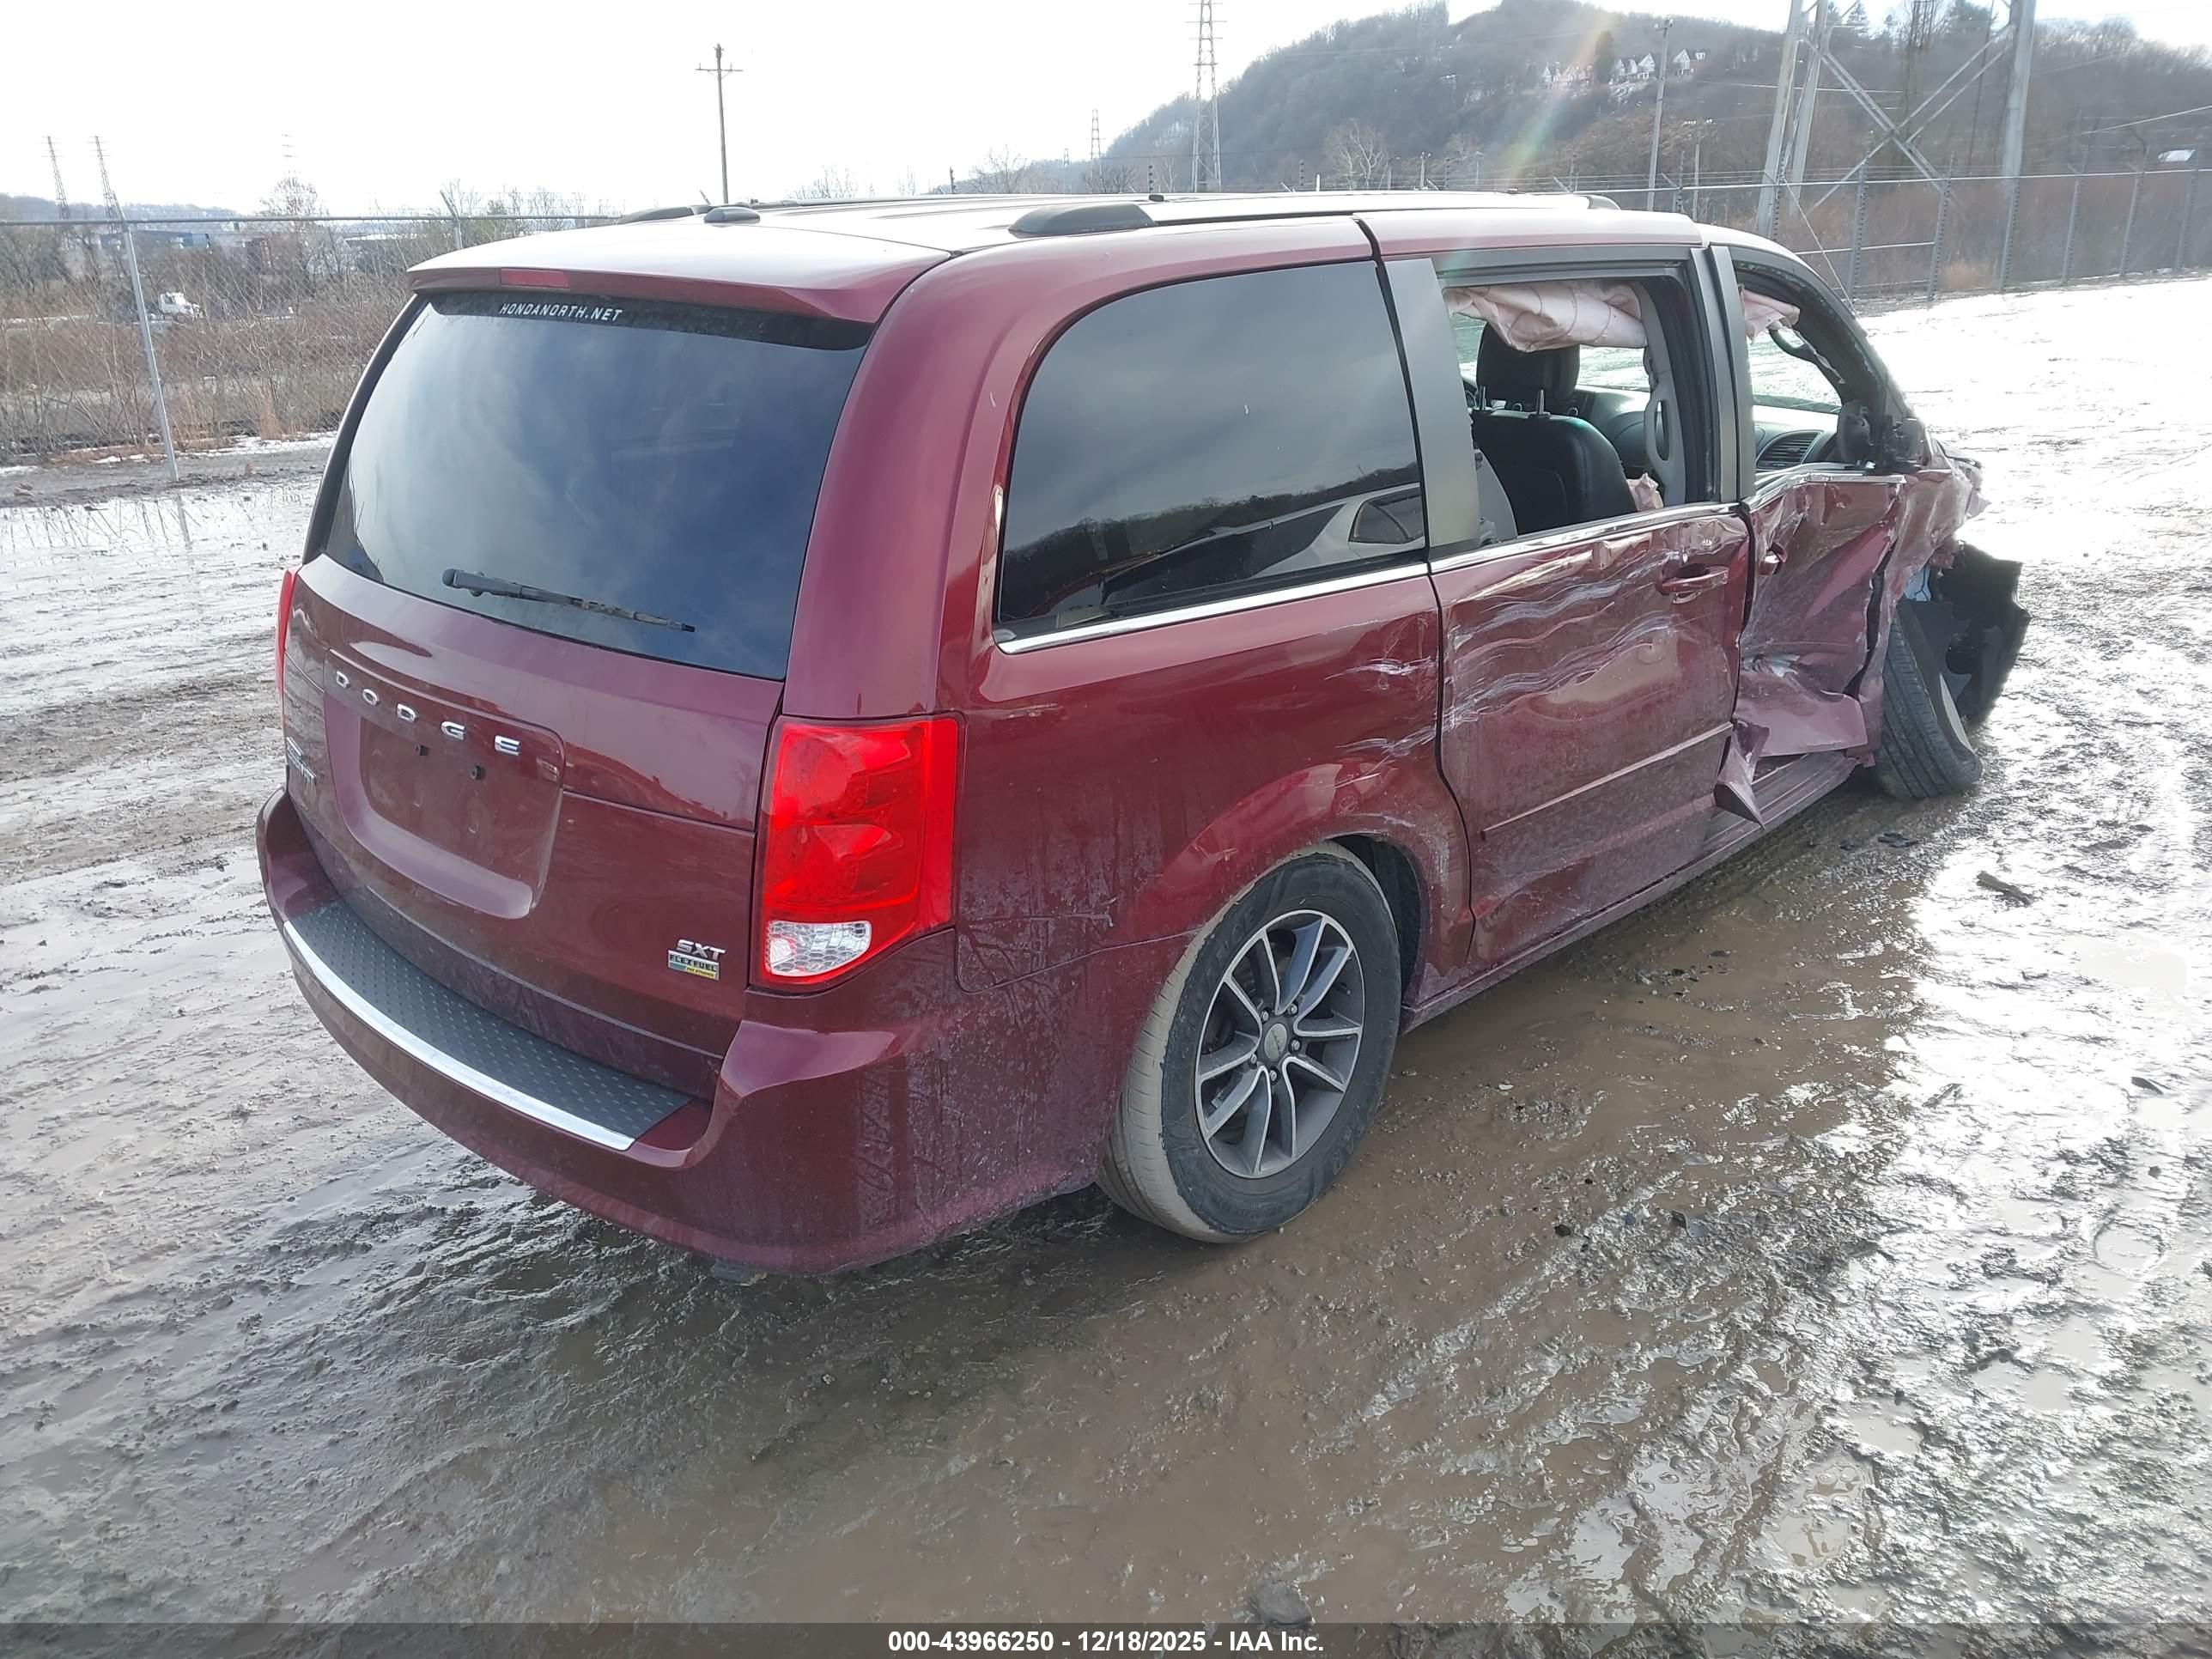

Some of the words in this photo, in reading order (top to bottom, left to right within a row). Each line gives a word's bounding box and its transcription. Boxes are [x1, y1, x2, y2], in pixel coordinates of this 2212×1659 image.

[498, 302, 623, 322] HONDANORTH.NET
[336, 670, 522, 757] DODGE
[676, 939, 726, 961] SXT
